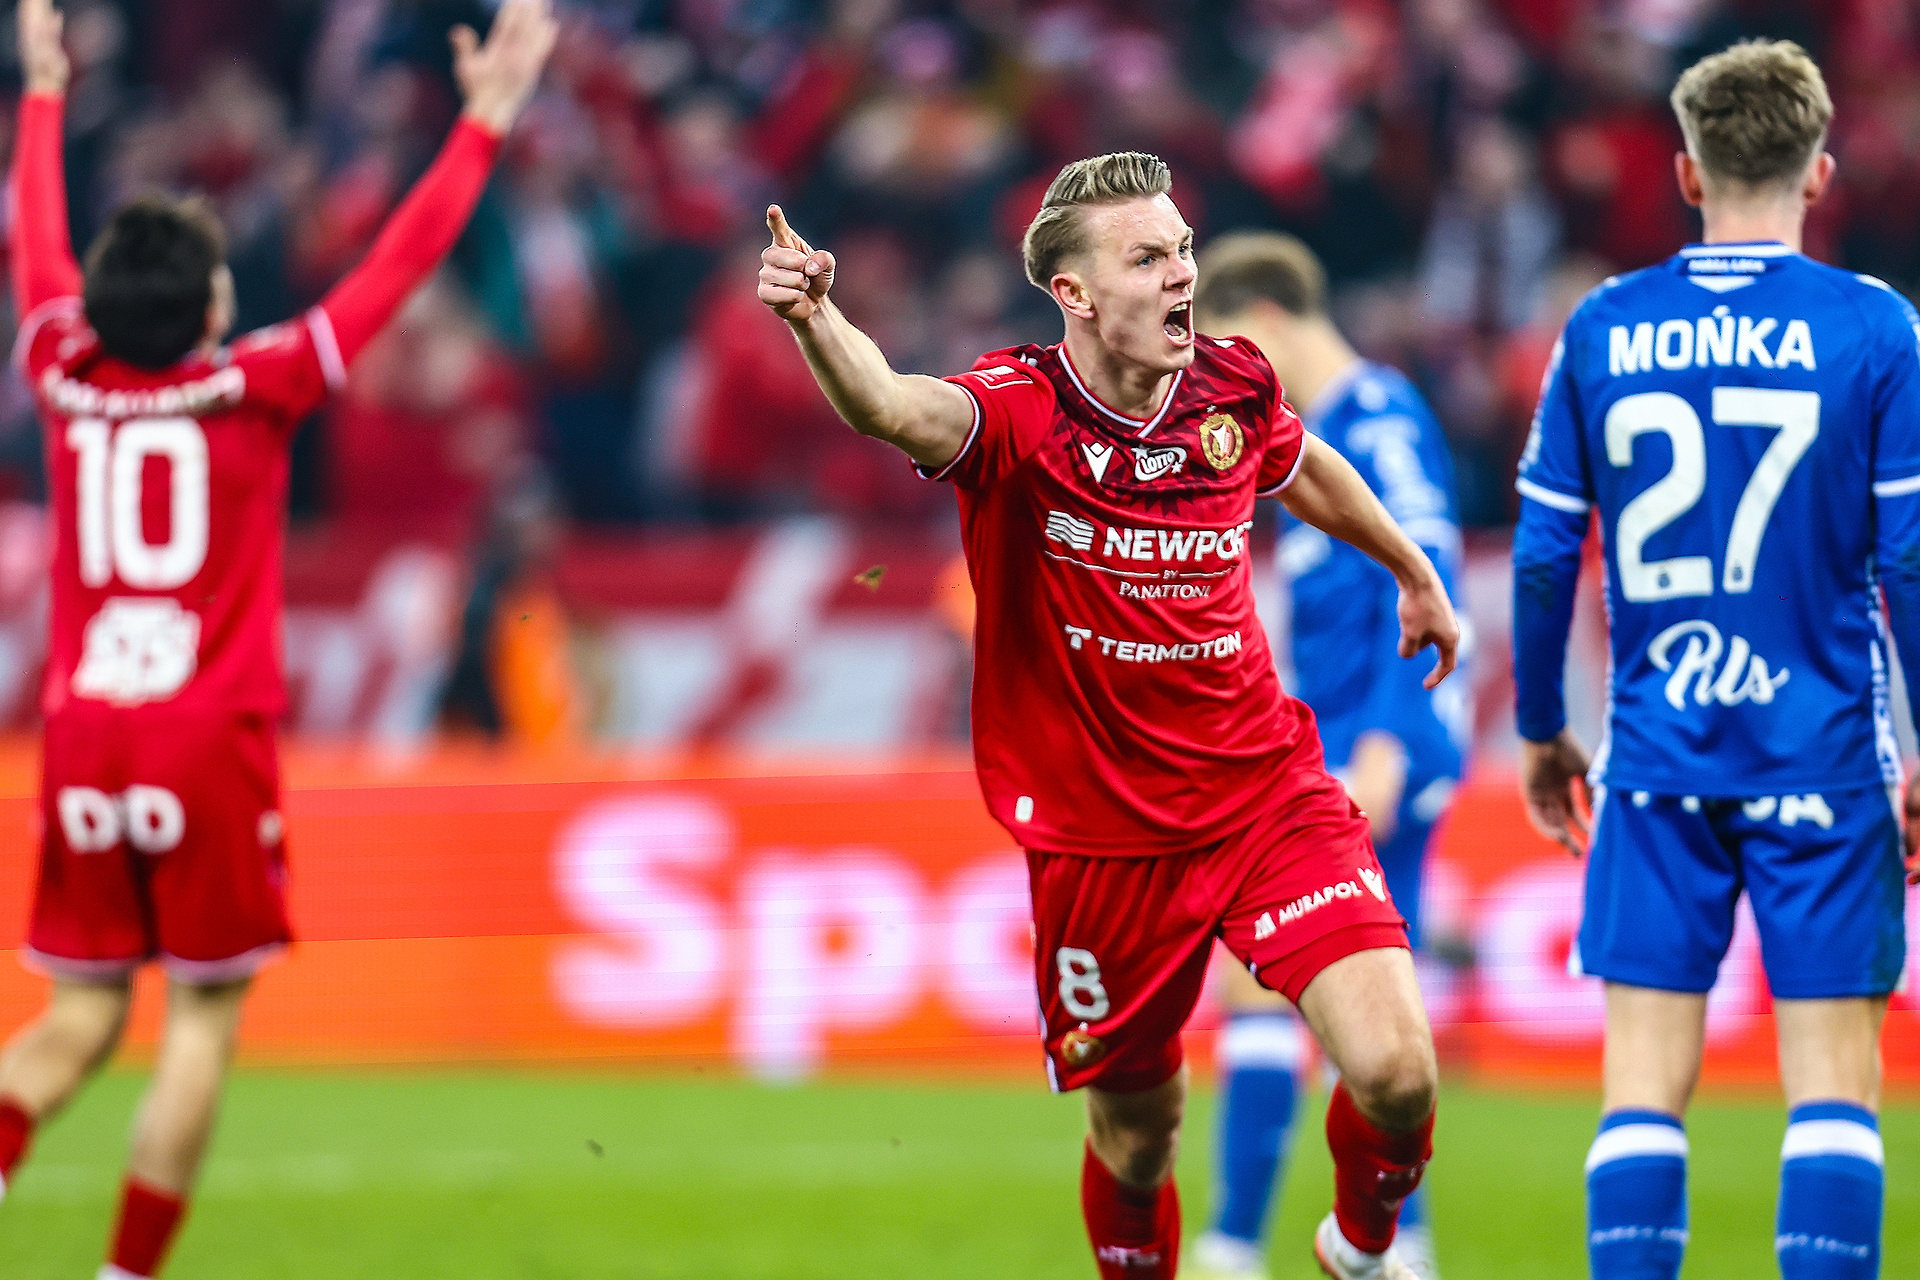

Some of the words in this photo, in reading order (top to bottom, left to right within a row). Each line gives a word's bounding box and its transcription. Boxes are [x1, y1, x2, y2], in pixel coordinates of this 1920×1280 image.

[1608, 305, 1818, 377] MOŃKA
[66, 415, 210, 590] 10
[1604, 383, 1822, 604] 27
[1118, 580, 1212, 600] PANATTONI
[1162, 569, 1179, 580] BY
[1097, 630, 1242, 663] TERMOTON
[1278, 880, 1363, 926] MURAPOL
[1056, 946, 1111, 1021] 8
